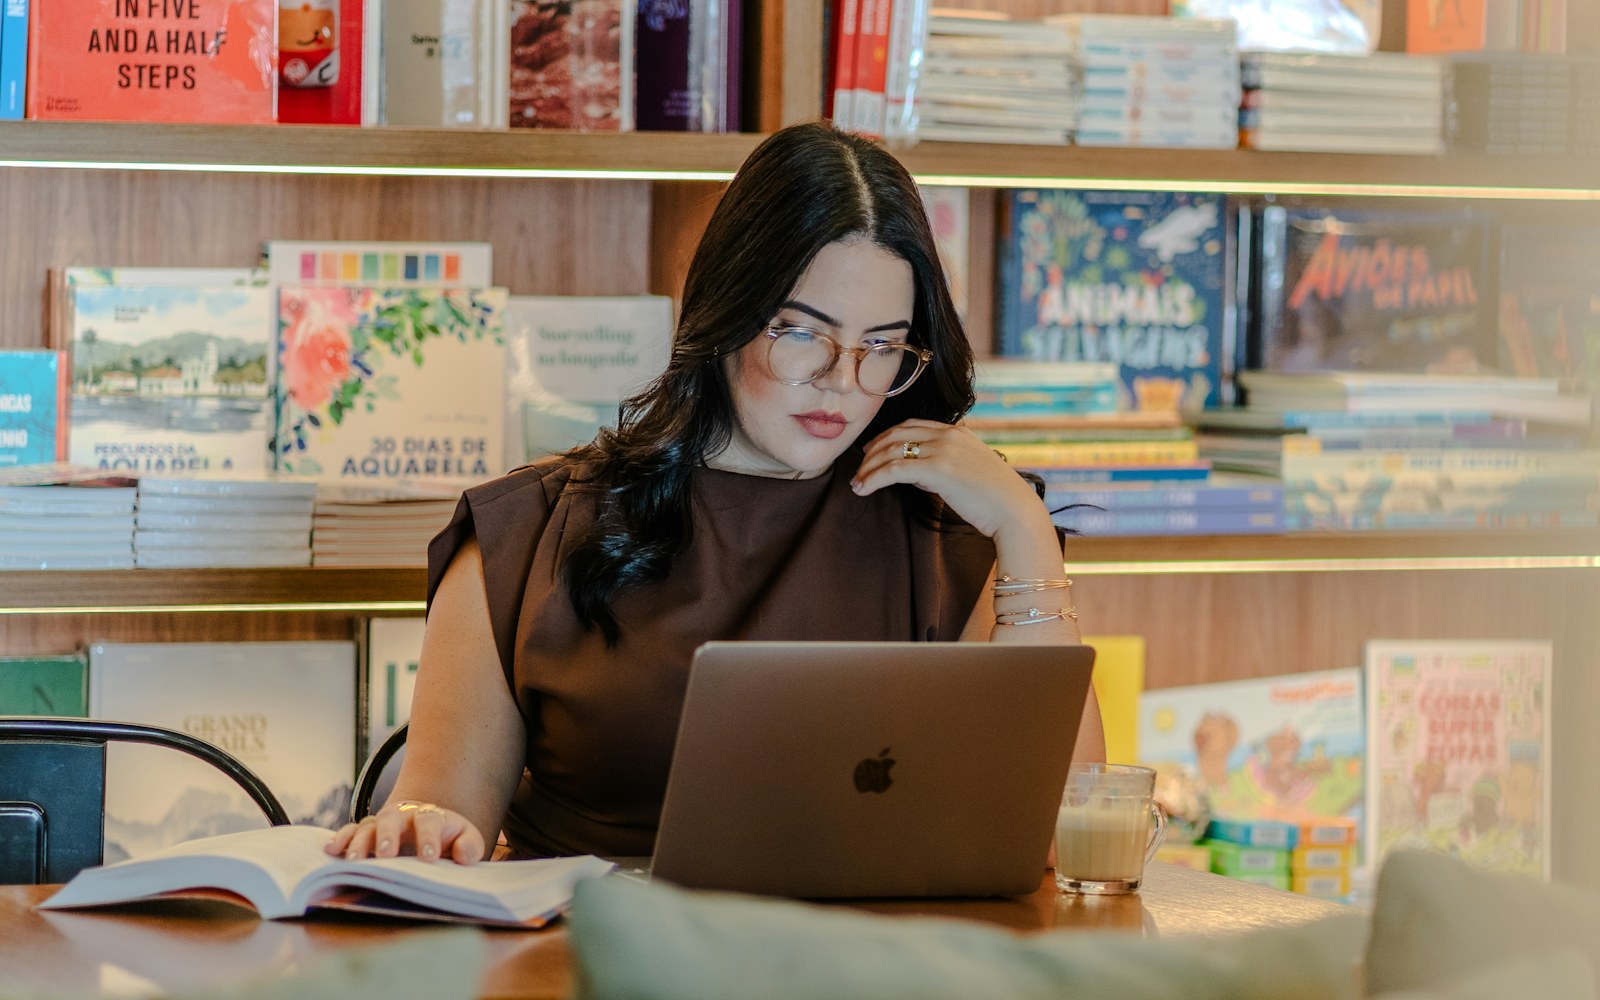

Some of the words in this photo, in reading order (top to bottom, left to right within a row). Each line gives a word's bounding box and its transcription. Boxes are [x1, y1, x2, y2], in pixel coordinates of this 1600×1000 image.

[116, 0, 138, 19] IN
[149, 0, 200, 19] FIVE
[88, 29, 138, 53] AND
[145, 29, 159, 53] A
[166, 30, 228, 56] HALF
[117, 64, 196, 90] STEPS
[95, 443, 173, 455] PERCURSOS
[178, 443, 196, 455] DA
[404, 437, 453, 454] DIAS
[462, 437, 487, 454] DE
[342, 457, 487, 475] AQUARELA
[183, 713, 269, 733] GRAND
[198, 734, 267, 751] AILS
